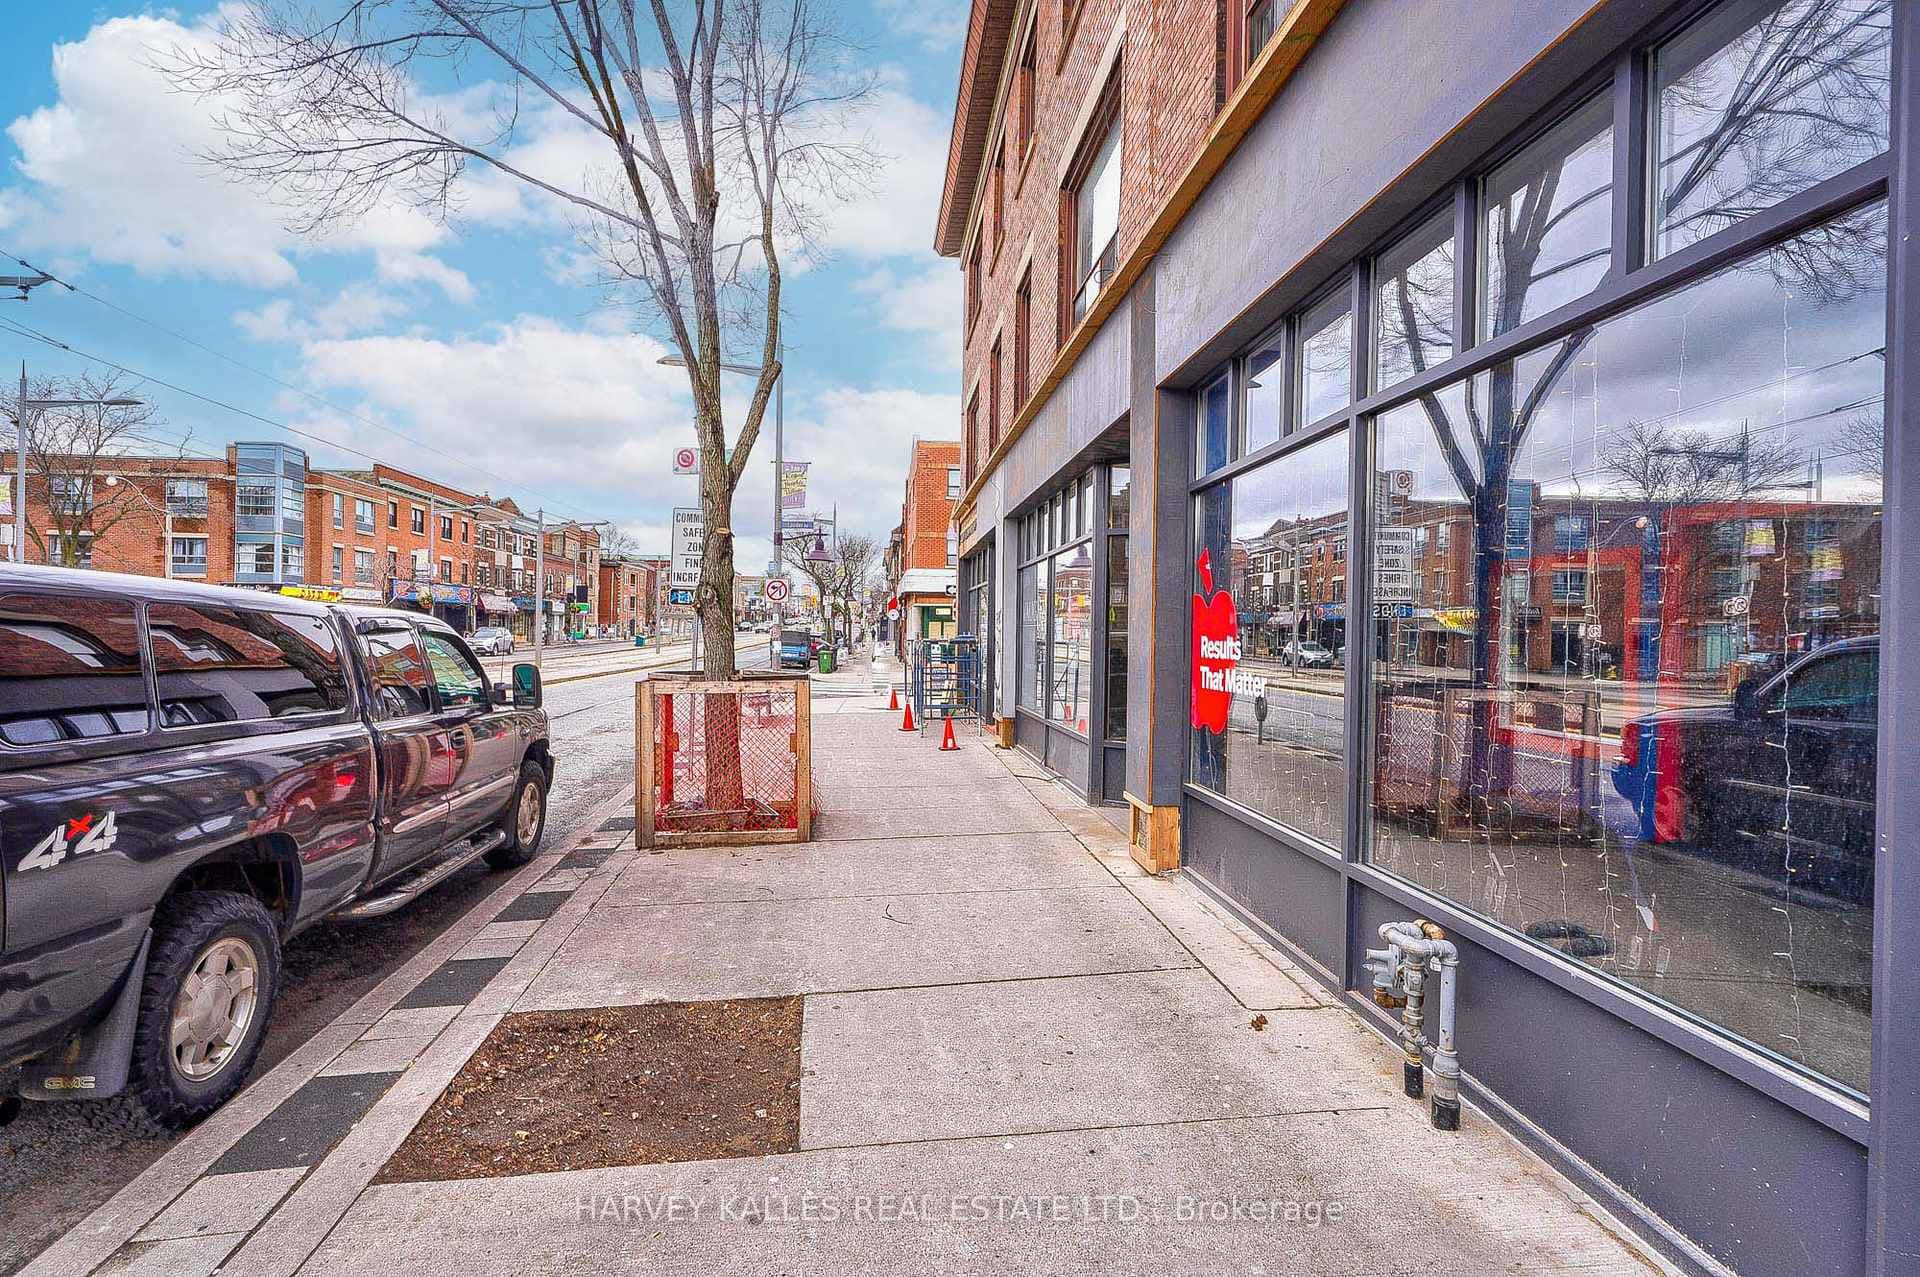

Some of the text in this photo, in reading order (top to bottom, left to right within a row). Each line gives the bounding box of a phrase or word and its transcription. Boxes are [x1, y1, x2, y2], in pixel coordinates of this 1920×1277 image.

[683, 527, 704, 538] SAFE
[687, 542, 704, 552] ZON
[685, 558, 704, 568] FINE
[1200, 635, 1242, 660] Results
[1200, 666, 1267, 697] That Matter
[44, 1076, 96, 1089] GMC
